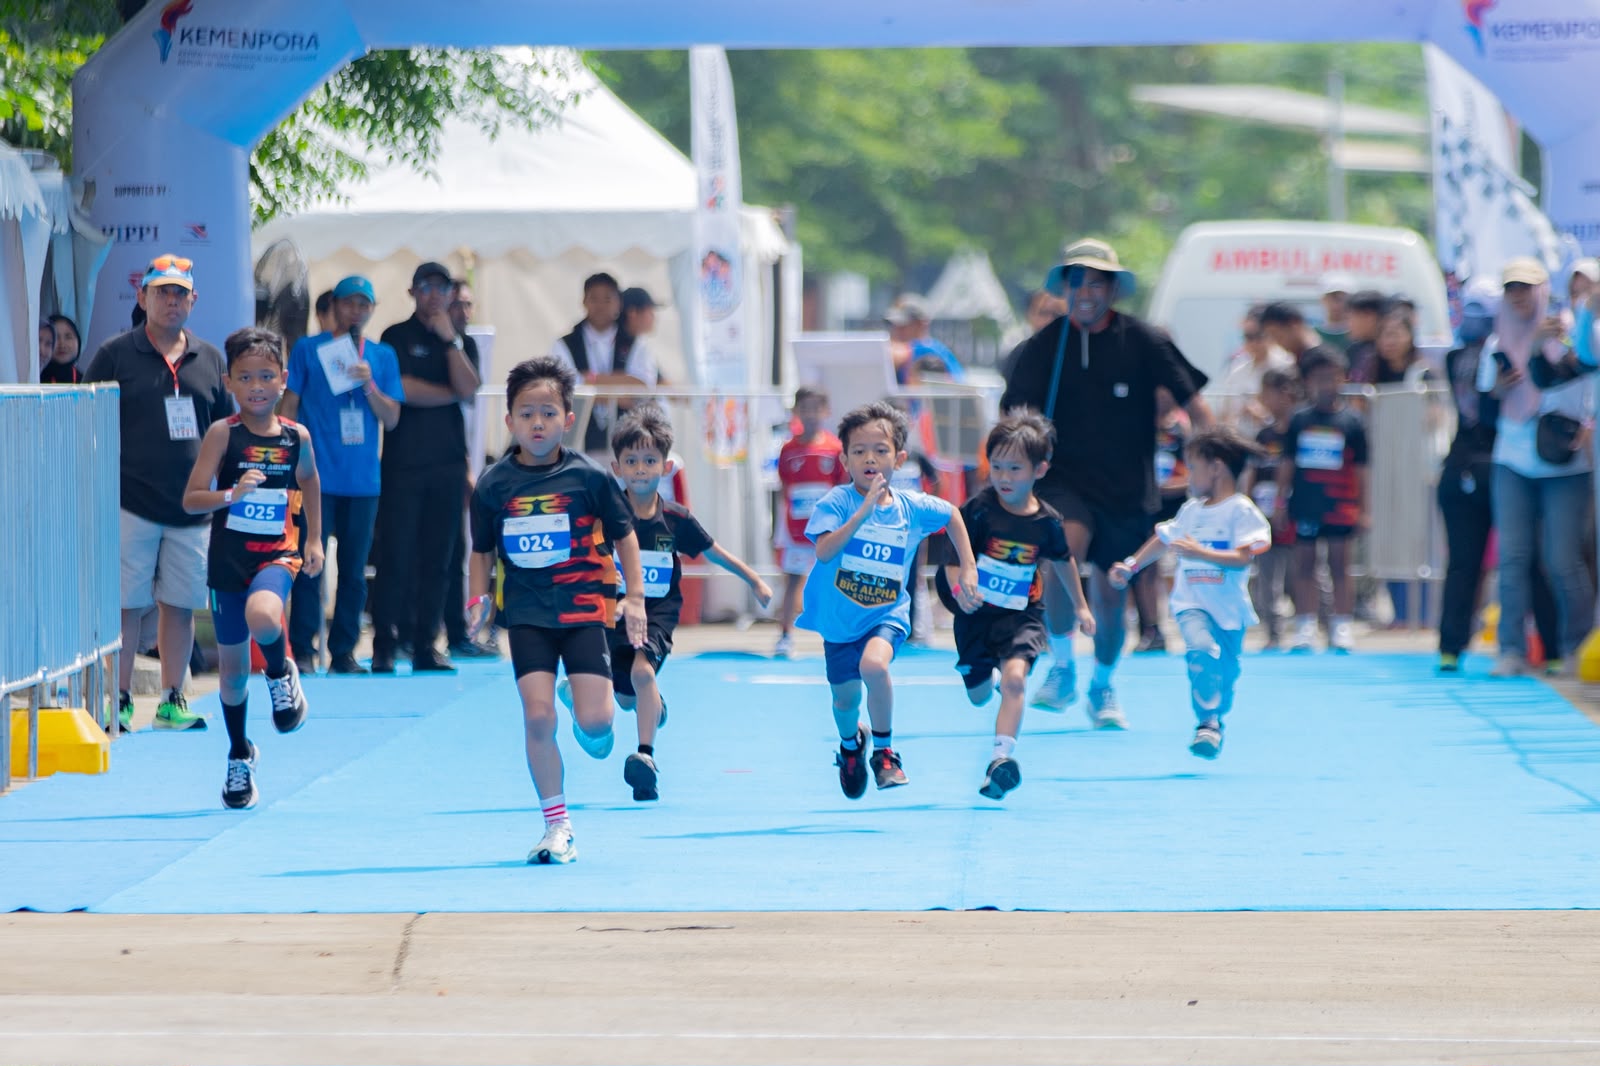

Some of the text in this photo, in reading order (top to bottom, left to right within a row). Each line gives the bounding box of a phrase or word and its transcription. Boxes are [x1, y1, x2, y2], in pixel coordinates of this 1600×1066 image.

[180, 27, 320, 51] KEMENPORA
[1212, 249, 1398, 276] AMBULANCE
[244, 503, 276, 521] 025
[518, 534, 555, 552] 024
[861, 542, 892, 562] 019
[839, 579, 897, 600] BIG ALPHA
[988, 576, 1017, 595] 017
[852, 592, 882, 604] SQUAD
